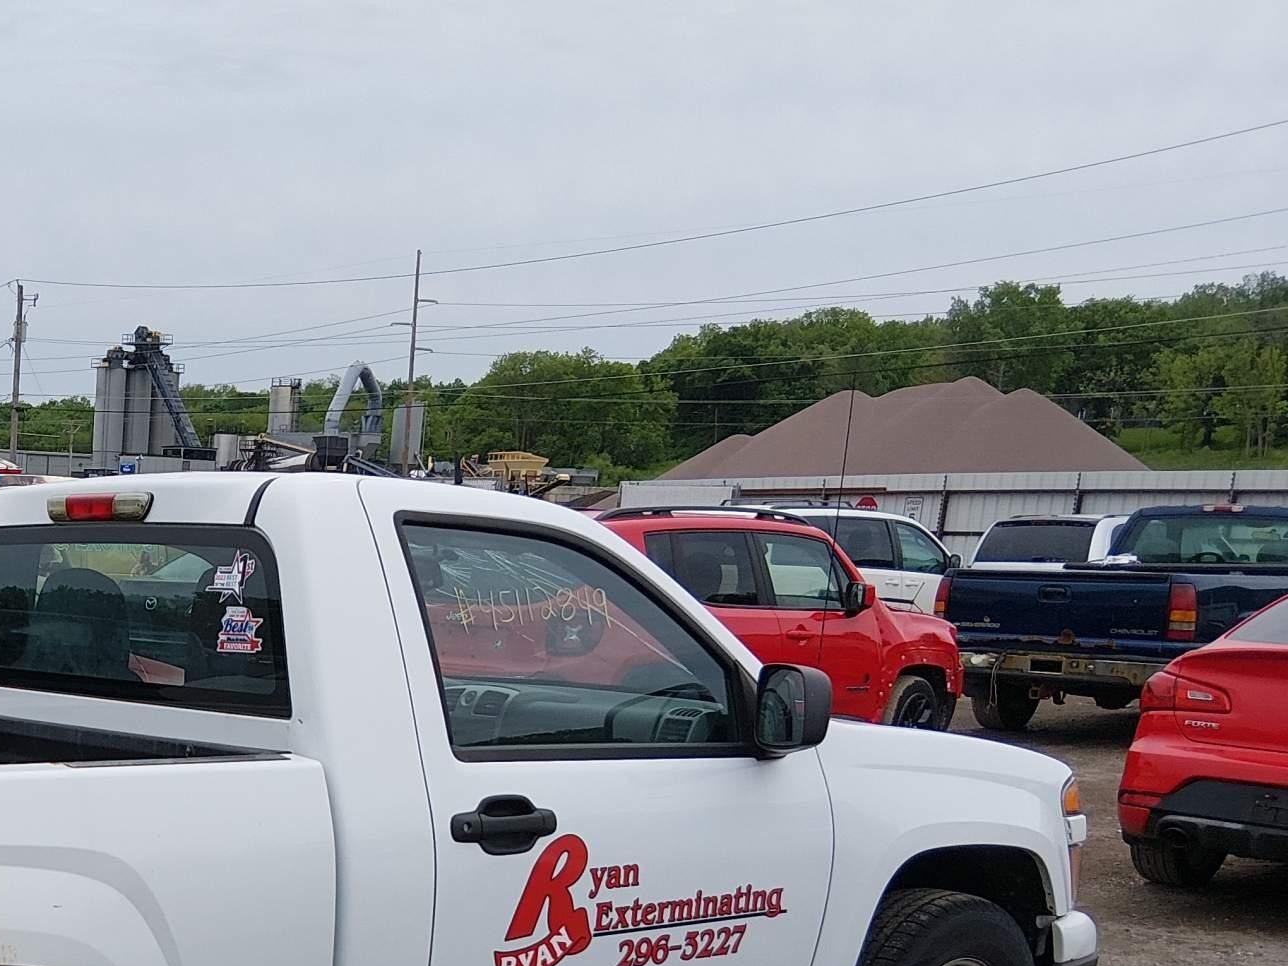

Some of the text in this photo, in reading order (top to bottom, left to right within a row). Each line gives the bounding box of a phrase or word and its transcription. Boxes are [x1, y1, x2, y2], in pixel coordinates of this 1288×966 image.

[224, 618, 249, 633] Best
[1184, 719, 1220, 729] FORTE
[593, 884, 785, 932] Exterminating
